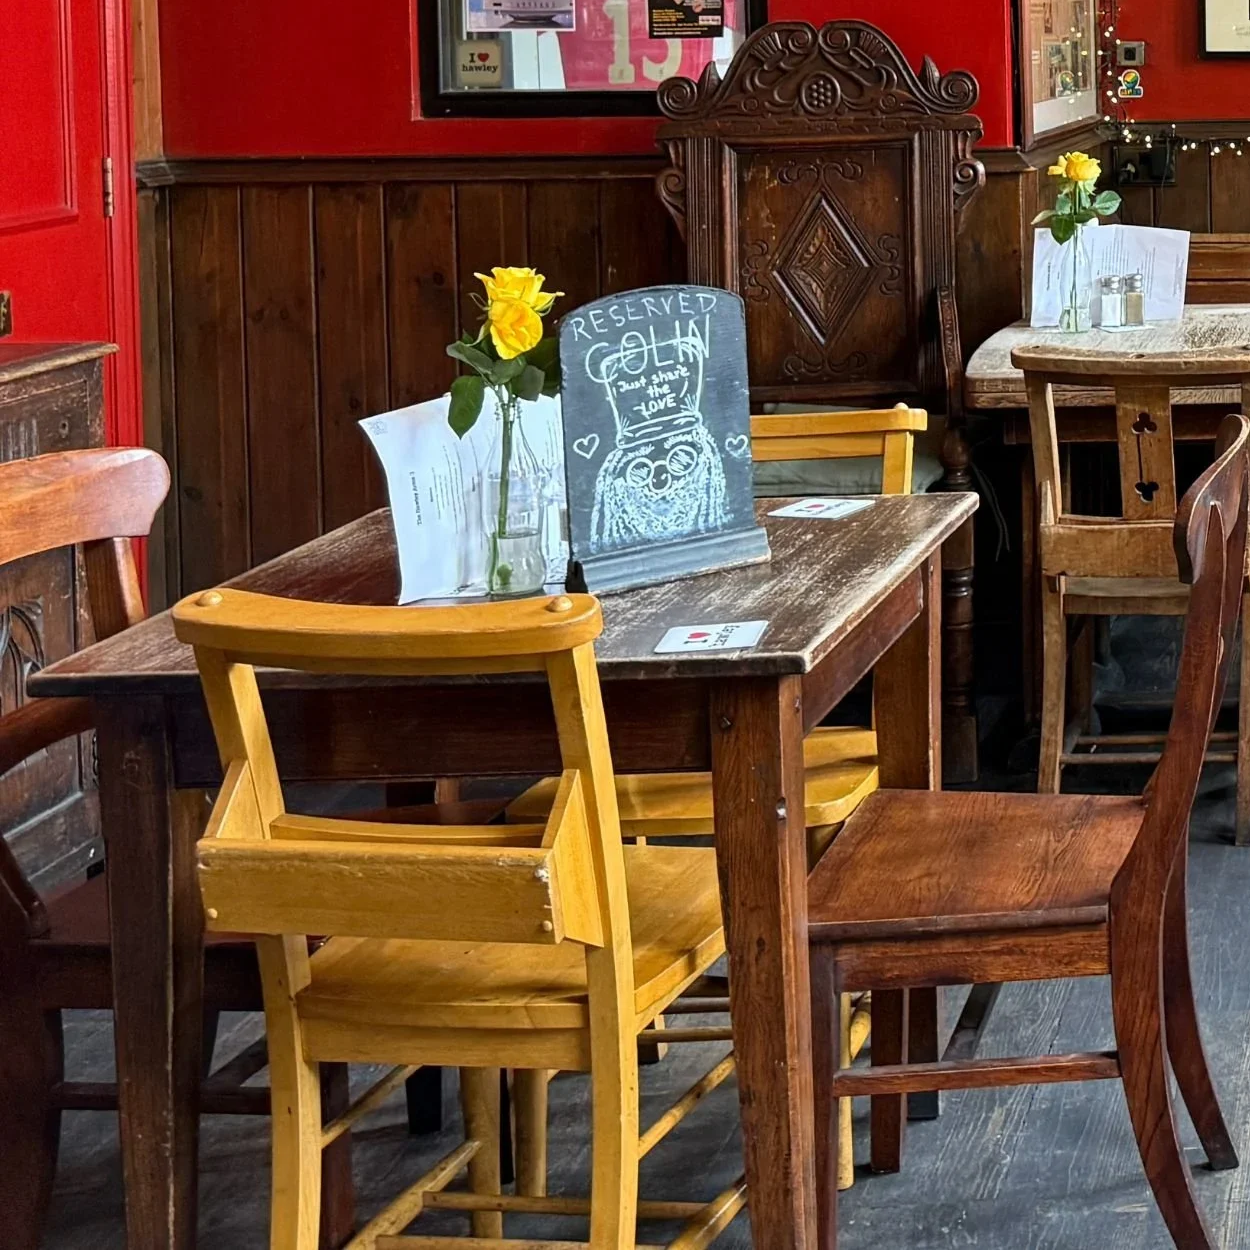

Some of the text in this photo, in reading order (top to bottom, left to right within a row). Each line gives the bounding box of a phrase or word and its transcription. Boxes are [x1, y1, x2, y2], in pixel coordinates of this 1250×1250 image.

[461, 62, 499, 74] hawley
[568, 292, 719, 343] RESERVED
[584, 313, 711, 384] COLIN
